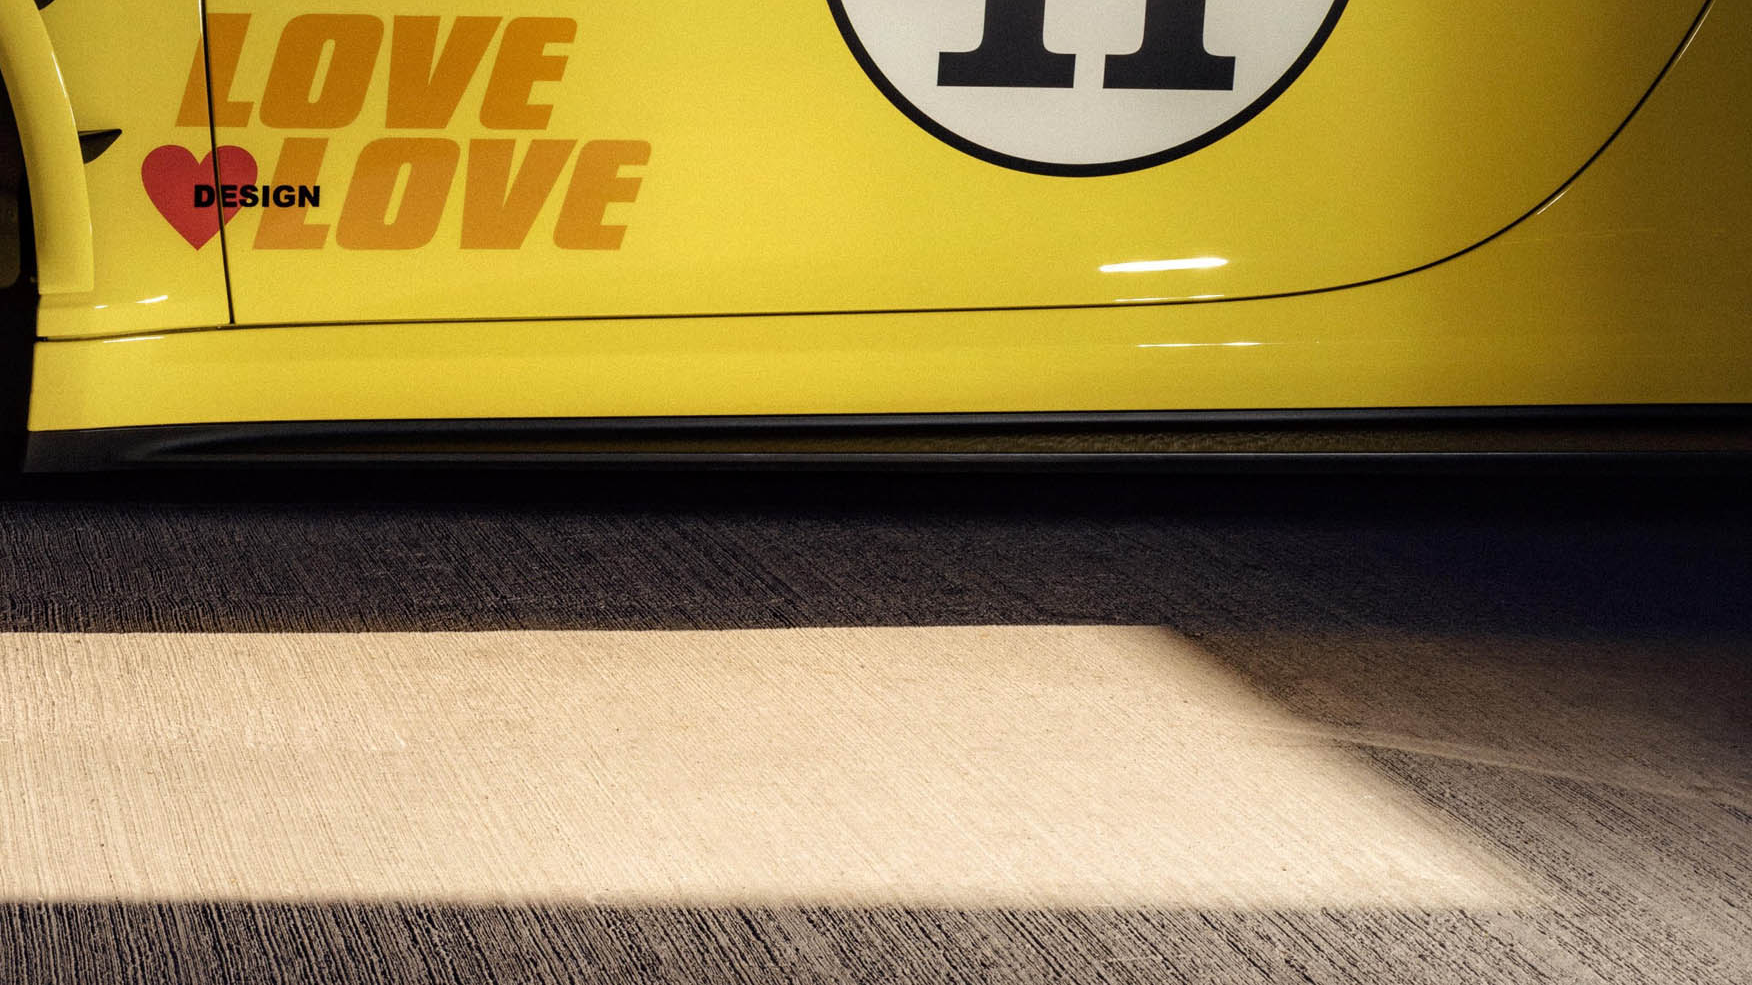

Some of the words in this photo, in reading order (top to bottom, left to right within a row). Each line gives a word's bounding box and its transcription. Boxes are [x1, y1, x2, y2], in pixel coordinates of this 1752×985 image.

[174, 12, 578, 130] LOVE
[193, 184, 321, 209] DESIGN
[252, 136, 652, 251] LOVE
